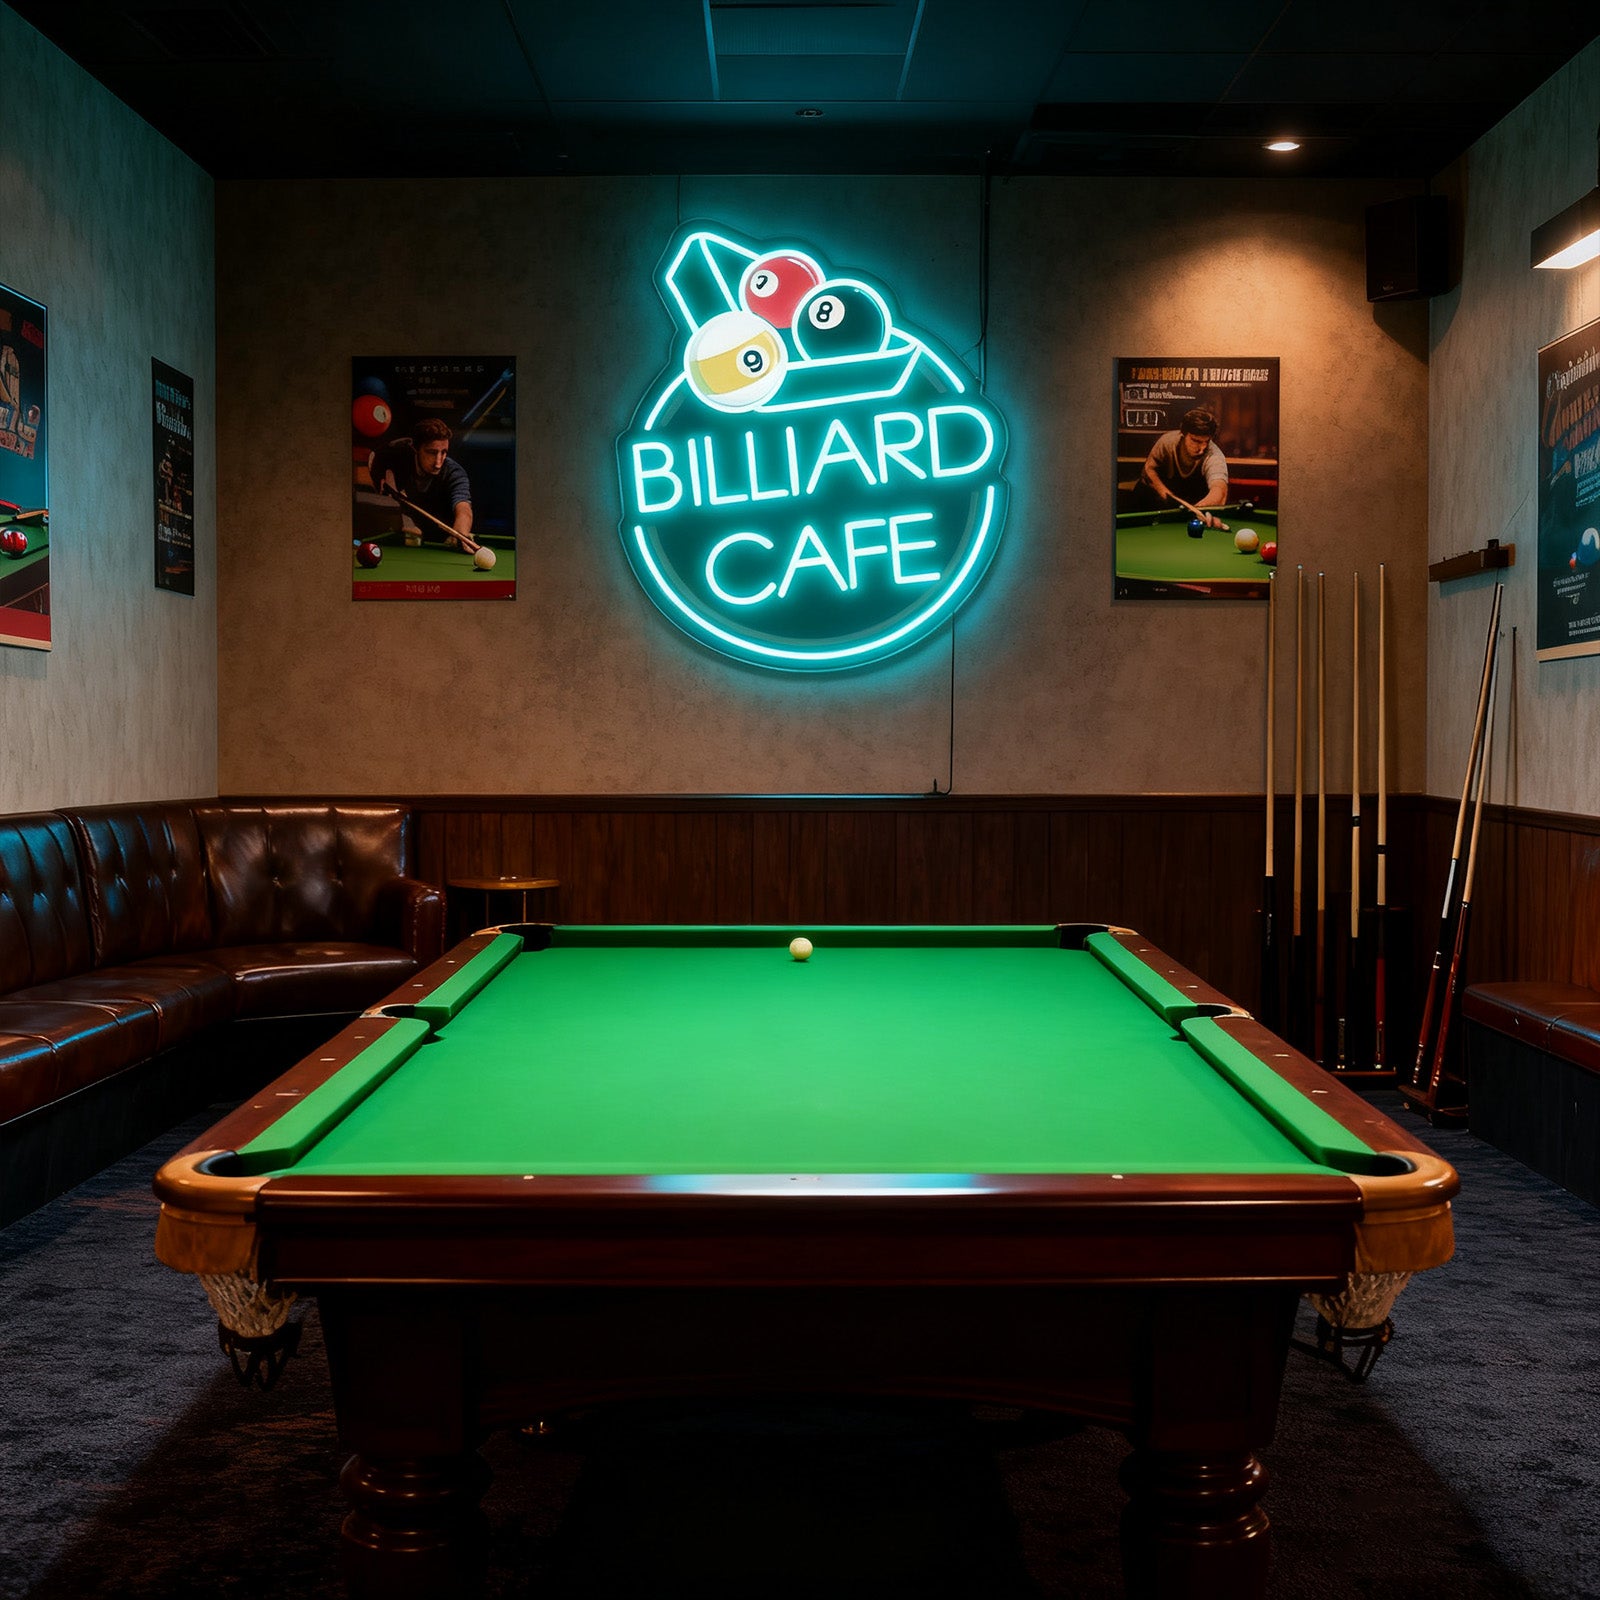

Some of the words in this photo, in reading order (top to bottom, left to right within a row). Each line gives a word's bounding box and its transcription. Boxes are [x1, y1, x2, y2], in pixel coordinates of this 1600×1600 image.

[816, 301, 833, 323] 8
[743, 350, 763, 373] 9
[632, 405, 994, 513] BILLIARD
[705, 512, 941, 605] CAFE
